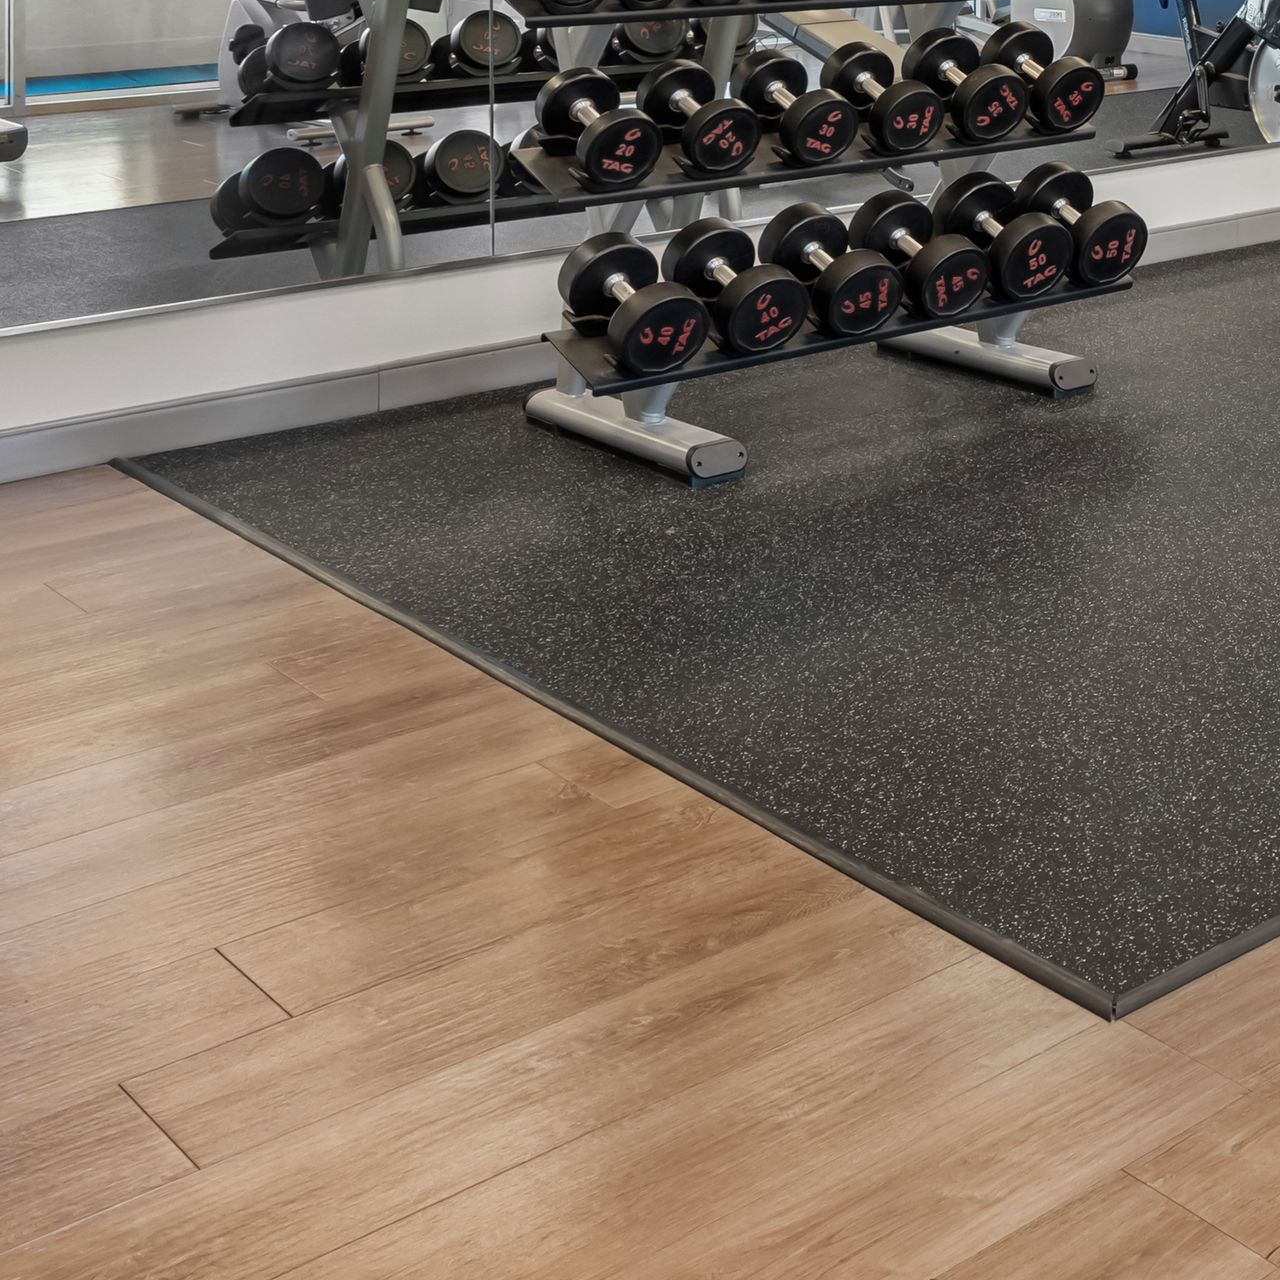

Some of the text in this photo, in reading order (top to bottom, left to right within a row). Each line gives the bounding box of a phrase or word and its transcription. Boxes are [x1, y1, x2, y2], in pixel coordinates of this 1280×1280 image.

[999, 83, 1020, 111] TAG
[1068, 90, 1084, 107] 35
[1053, 96, 1071, 123] TAG
[818, 123, 836, 138] 30
[906, 113, 919, 130] 30
[918, 105, 935, 137] TAG
[615, 143, 636, 157] 20
[804, 136, 833, 155] TAG
[602, 158, 635, 174] TAG
[1106, 239, 1119, 260] 50
[1120, 228, 1137, 264] TAG
[1027, 253, 1048, 270] 50
[951, 275, 965, 293] 45
[1022, 264, 1057, 289] TAG
[857, 291, 873, 310] 45
[876, 277, 890, 313] TAG
[935, 274, 949, 309] TAG
[759, 305, 780, 325] 40
[657, 325, 675, 347] 40
[671, 317, 698, 356] TAG
[754, 315, 794, 343] TAG
